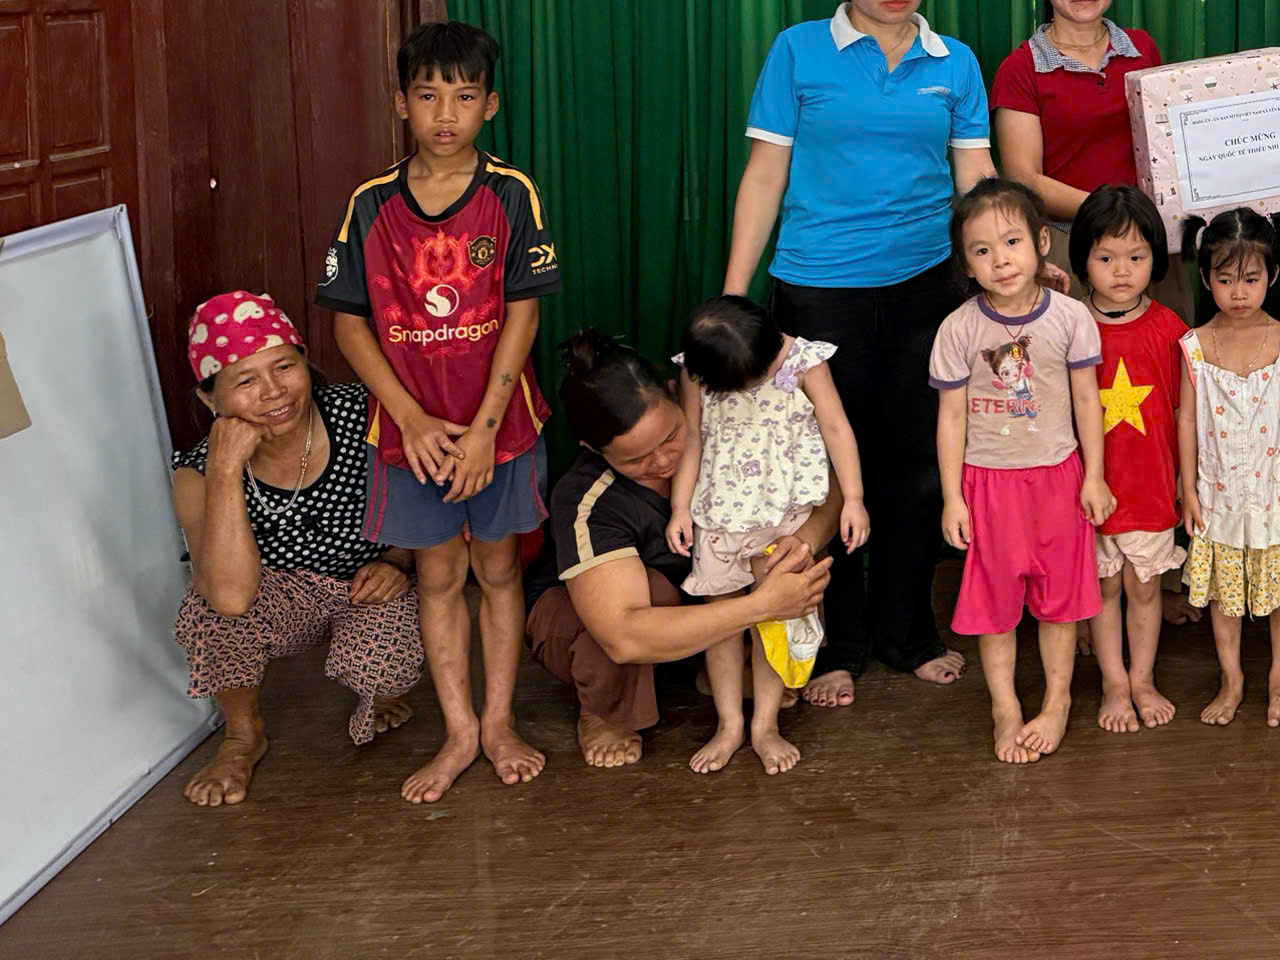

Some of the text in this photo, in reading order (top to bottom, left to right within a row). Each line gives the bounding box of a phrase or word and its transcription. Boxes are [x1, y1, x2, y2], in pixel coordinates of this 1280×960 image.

[1224, 131, 1276, 147] CHÚC MỪNG
[1199, 152, 1217, 162] NGÀY
[1218, 150, 1236, 161] QUỐC
[1267, 143, 1280, 152] NHI
[388, 319, 499, 347] Snapdragon
